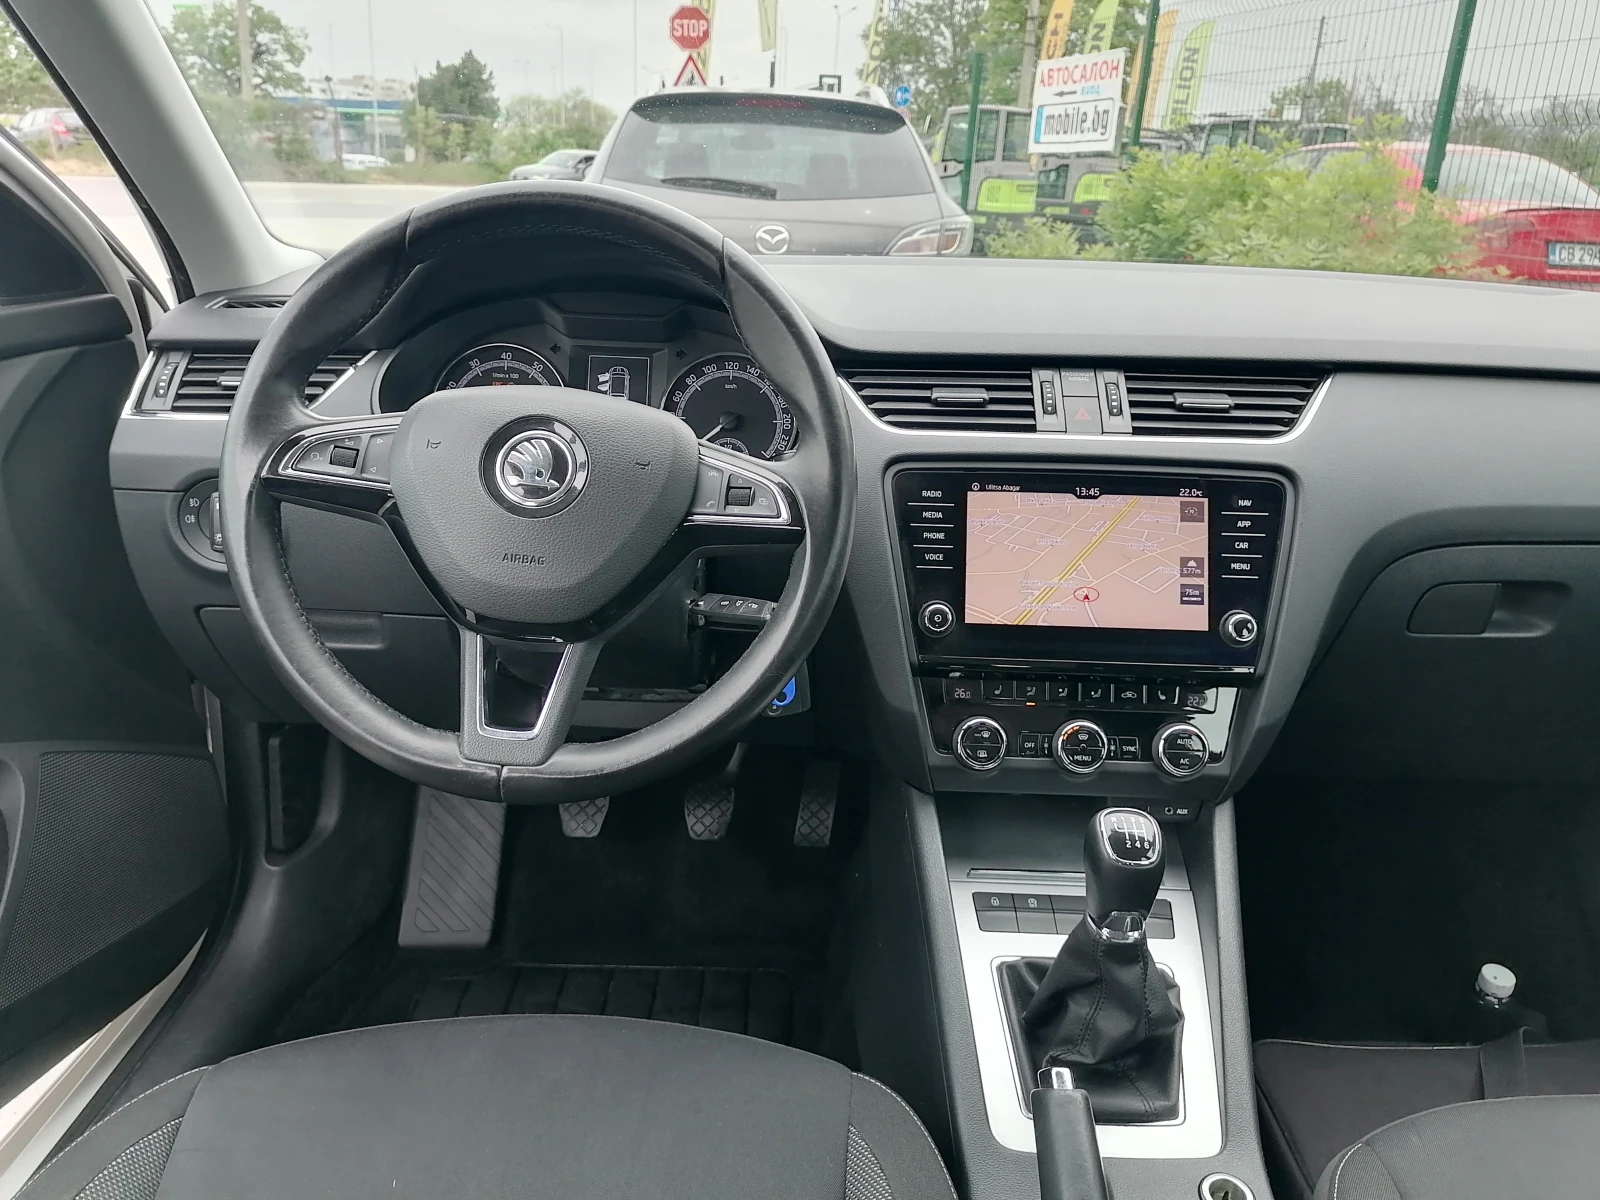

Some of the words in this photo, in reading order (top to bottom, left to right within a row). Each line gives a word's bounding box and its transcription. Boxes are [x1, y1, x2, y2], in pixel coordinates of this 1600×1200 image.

[672, 18, 709, 37] STOP
[1038, 58, 1121, 88] АВТОСАЛОН
[1043, 105, 1110, 136] mobile.bg
[500, 352, 513, 360] 40
[468, 358, 481, 369] 30
[531, 361, 544, 373] 50
[724, 361, 740, 370] 120
[701, 363, 717, 374] 100
[745, 364, 760, 377] 140
[685, 374, 697, 386] 80
[672, 390, 683, 403] 60
[783, 413, 792, 430] 200
[777, 434, 790, 452] 230
[922, 490, 942, 498] RADIO
[1075, 487, 1100, 496] 13:45
[1238, 499, 1253, 507] NAV
[922, 511, 943, 519] MEDIA
[1236, 520, 1252, 528] APP
[923, 532, 945, 540] PHONE
[1234, 541, 1249, 549] CAR
[502, 552, 546, 566] AIRBAG
[924, 553, 944, 561] VOICE
[1182, 567, 1202, 575] 577m
[1230, 562, 1251, 571] MENU
[1185, 588, 1200, 596] 75m
[1073, 754, 1092, 762] MENU
[1125, 840, 1132, 848] 2
[1134, 840, 1141, 848] 4
